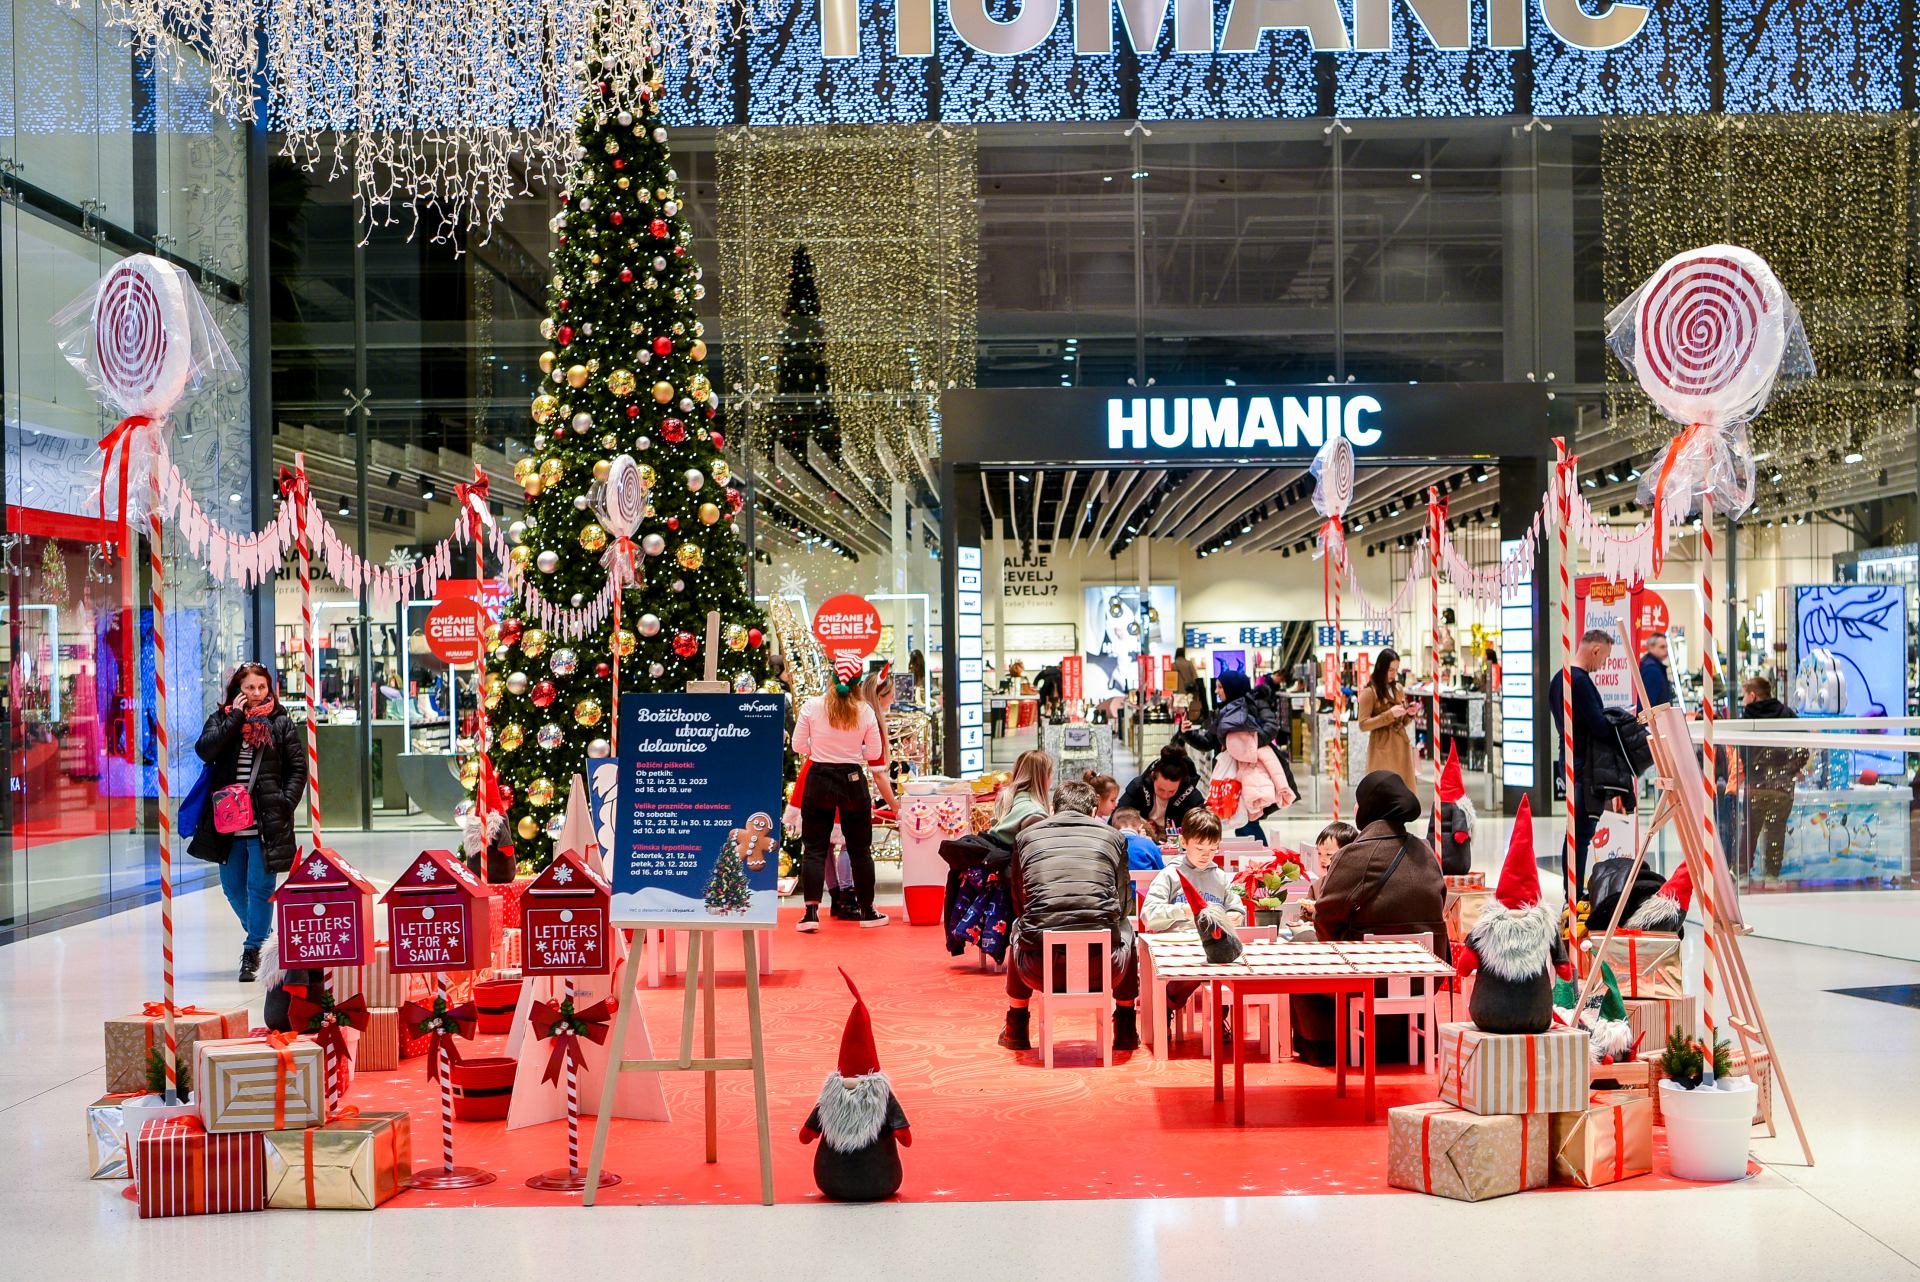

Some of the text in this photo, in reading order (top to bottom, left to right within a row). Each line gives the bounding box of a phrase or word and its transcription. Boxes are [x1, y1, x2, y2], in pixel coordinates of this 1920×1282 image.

[1107, 395, 1383, 449] HUMANIC
[1030, 556, 1048, 567] JE
[1004, 571, 1054, 582] EVELJ
[430, 615, 475, 625] ZNIŽANE
[818, 613, 863, 623] ZNIŽANE
[430, 625, 475, 637] CENE
[818, 622, 863, 635] CENE
[1608, 657, 1628, 670] POKUS
[1595, 674, 1619, 687] CIRKUS
[637, 708, 712, 722] Božičkove
[638, 739, 708, 753] delavnice
[630, 860, 654, 868] petek,
[290, 917, 351, 933] LETTERS
[400, 921, 461, 936] LETTERS
[535, 924, 598, 939] LETTERS
[308, 932, 331, 944] FOR
[417, 936, 440, 948] FOR
[299, 944, 341, 957] SANTA
[552, 939, 576, 951] FOR
[409, 948, 450, 962] SANTA
[543, 951, 586, 965] SANTA
